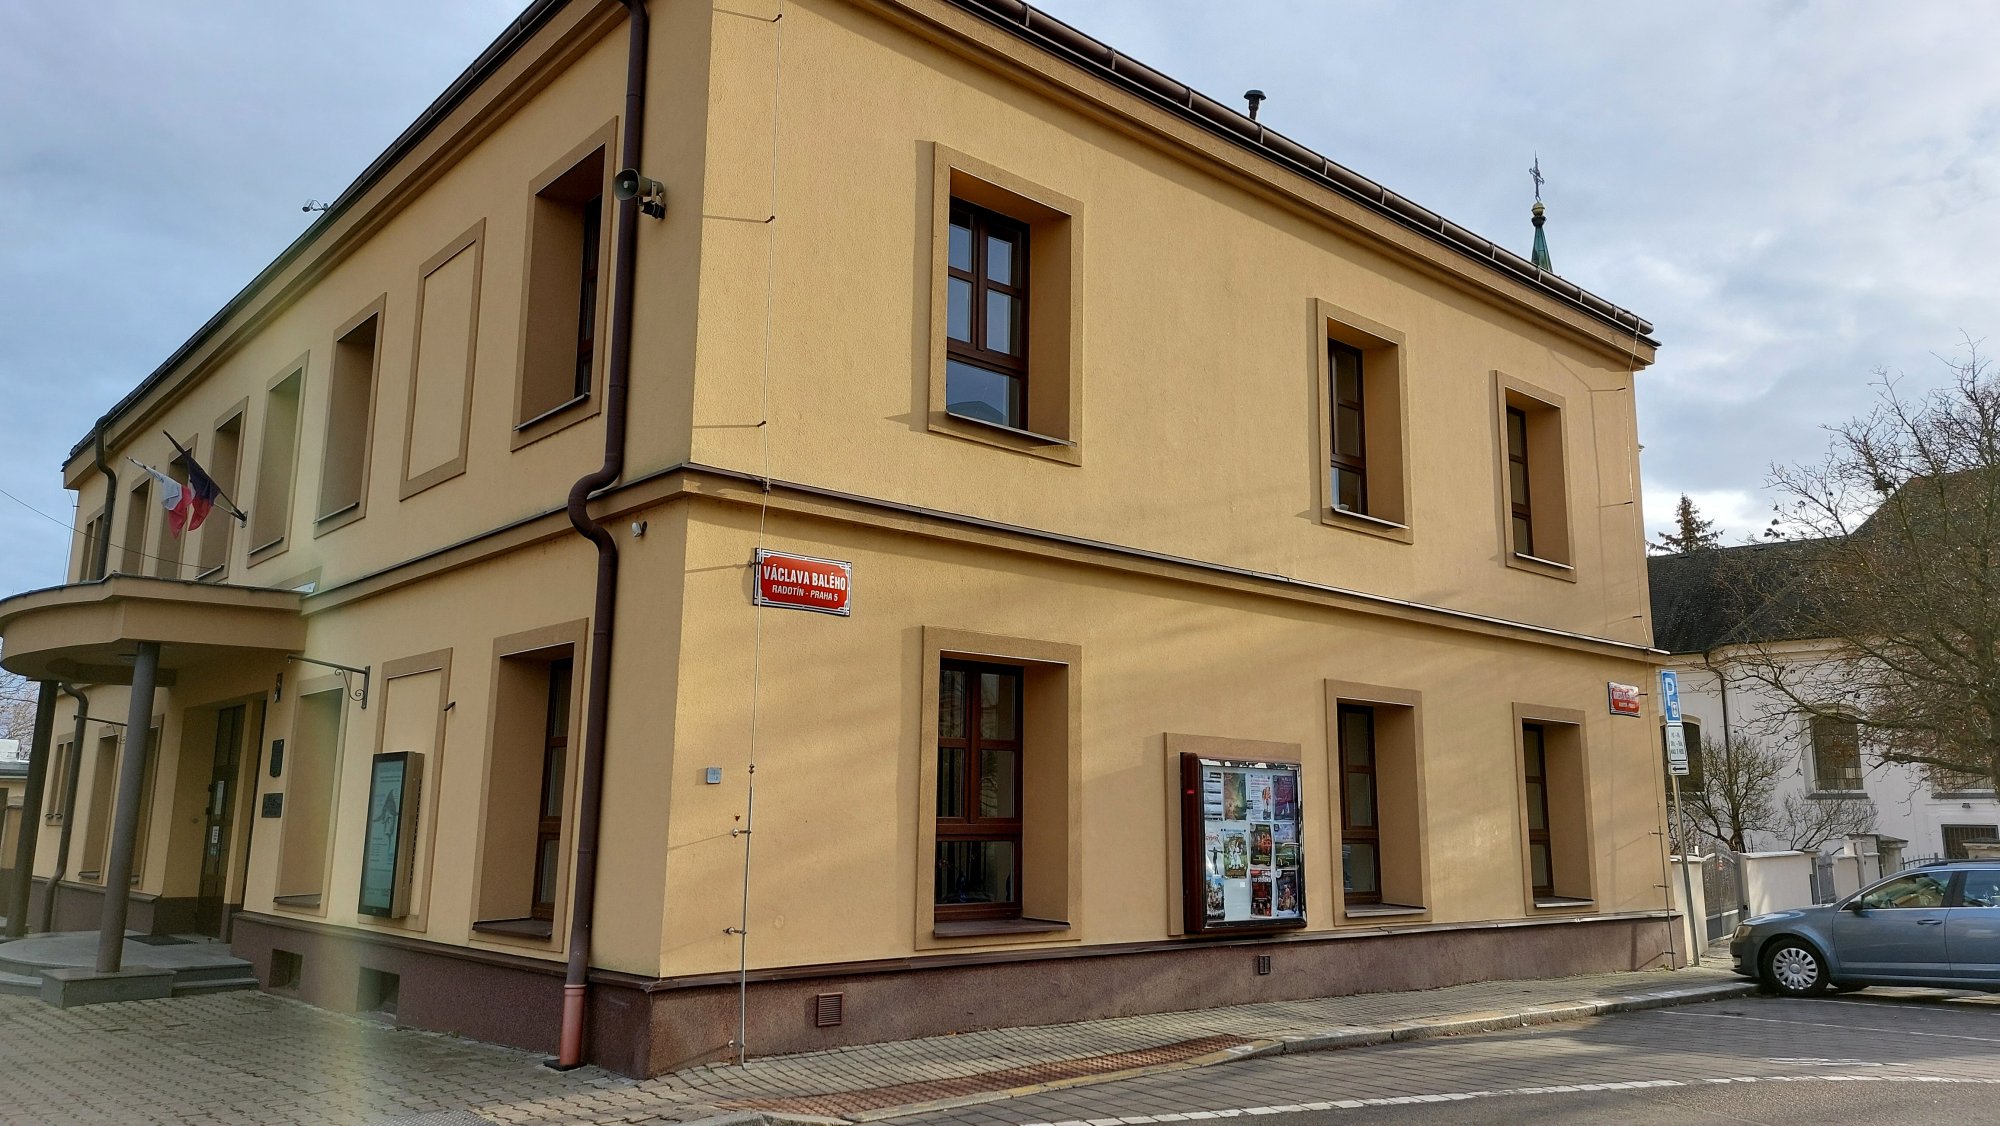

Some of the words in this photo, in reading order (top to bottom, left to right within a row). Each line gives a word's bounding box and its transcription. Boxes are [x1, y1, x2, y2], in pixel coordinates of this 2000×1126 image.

[764, 564, 810, 585] VÁCLAVA
[812, 572, 846, 590] BALÉHO
[772, 585, 804, 596] RADOTÍN
[810, 590, 833, 601] PRAHA
[833, 593, 838, 601] 5
[1665, 678, 1675, 706] P
